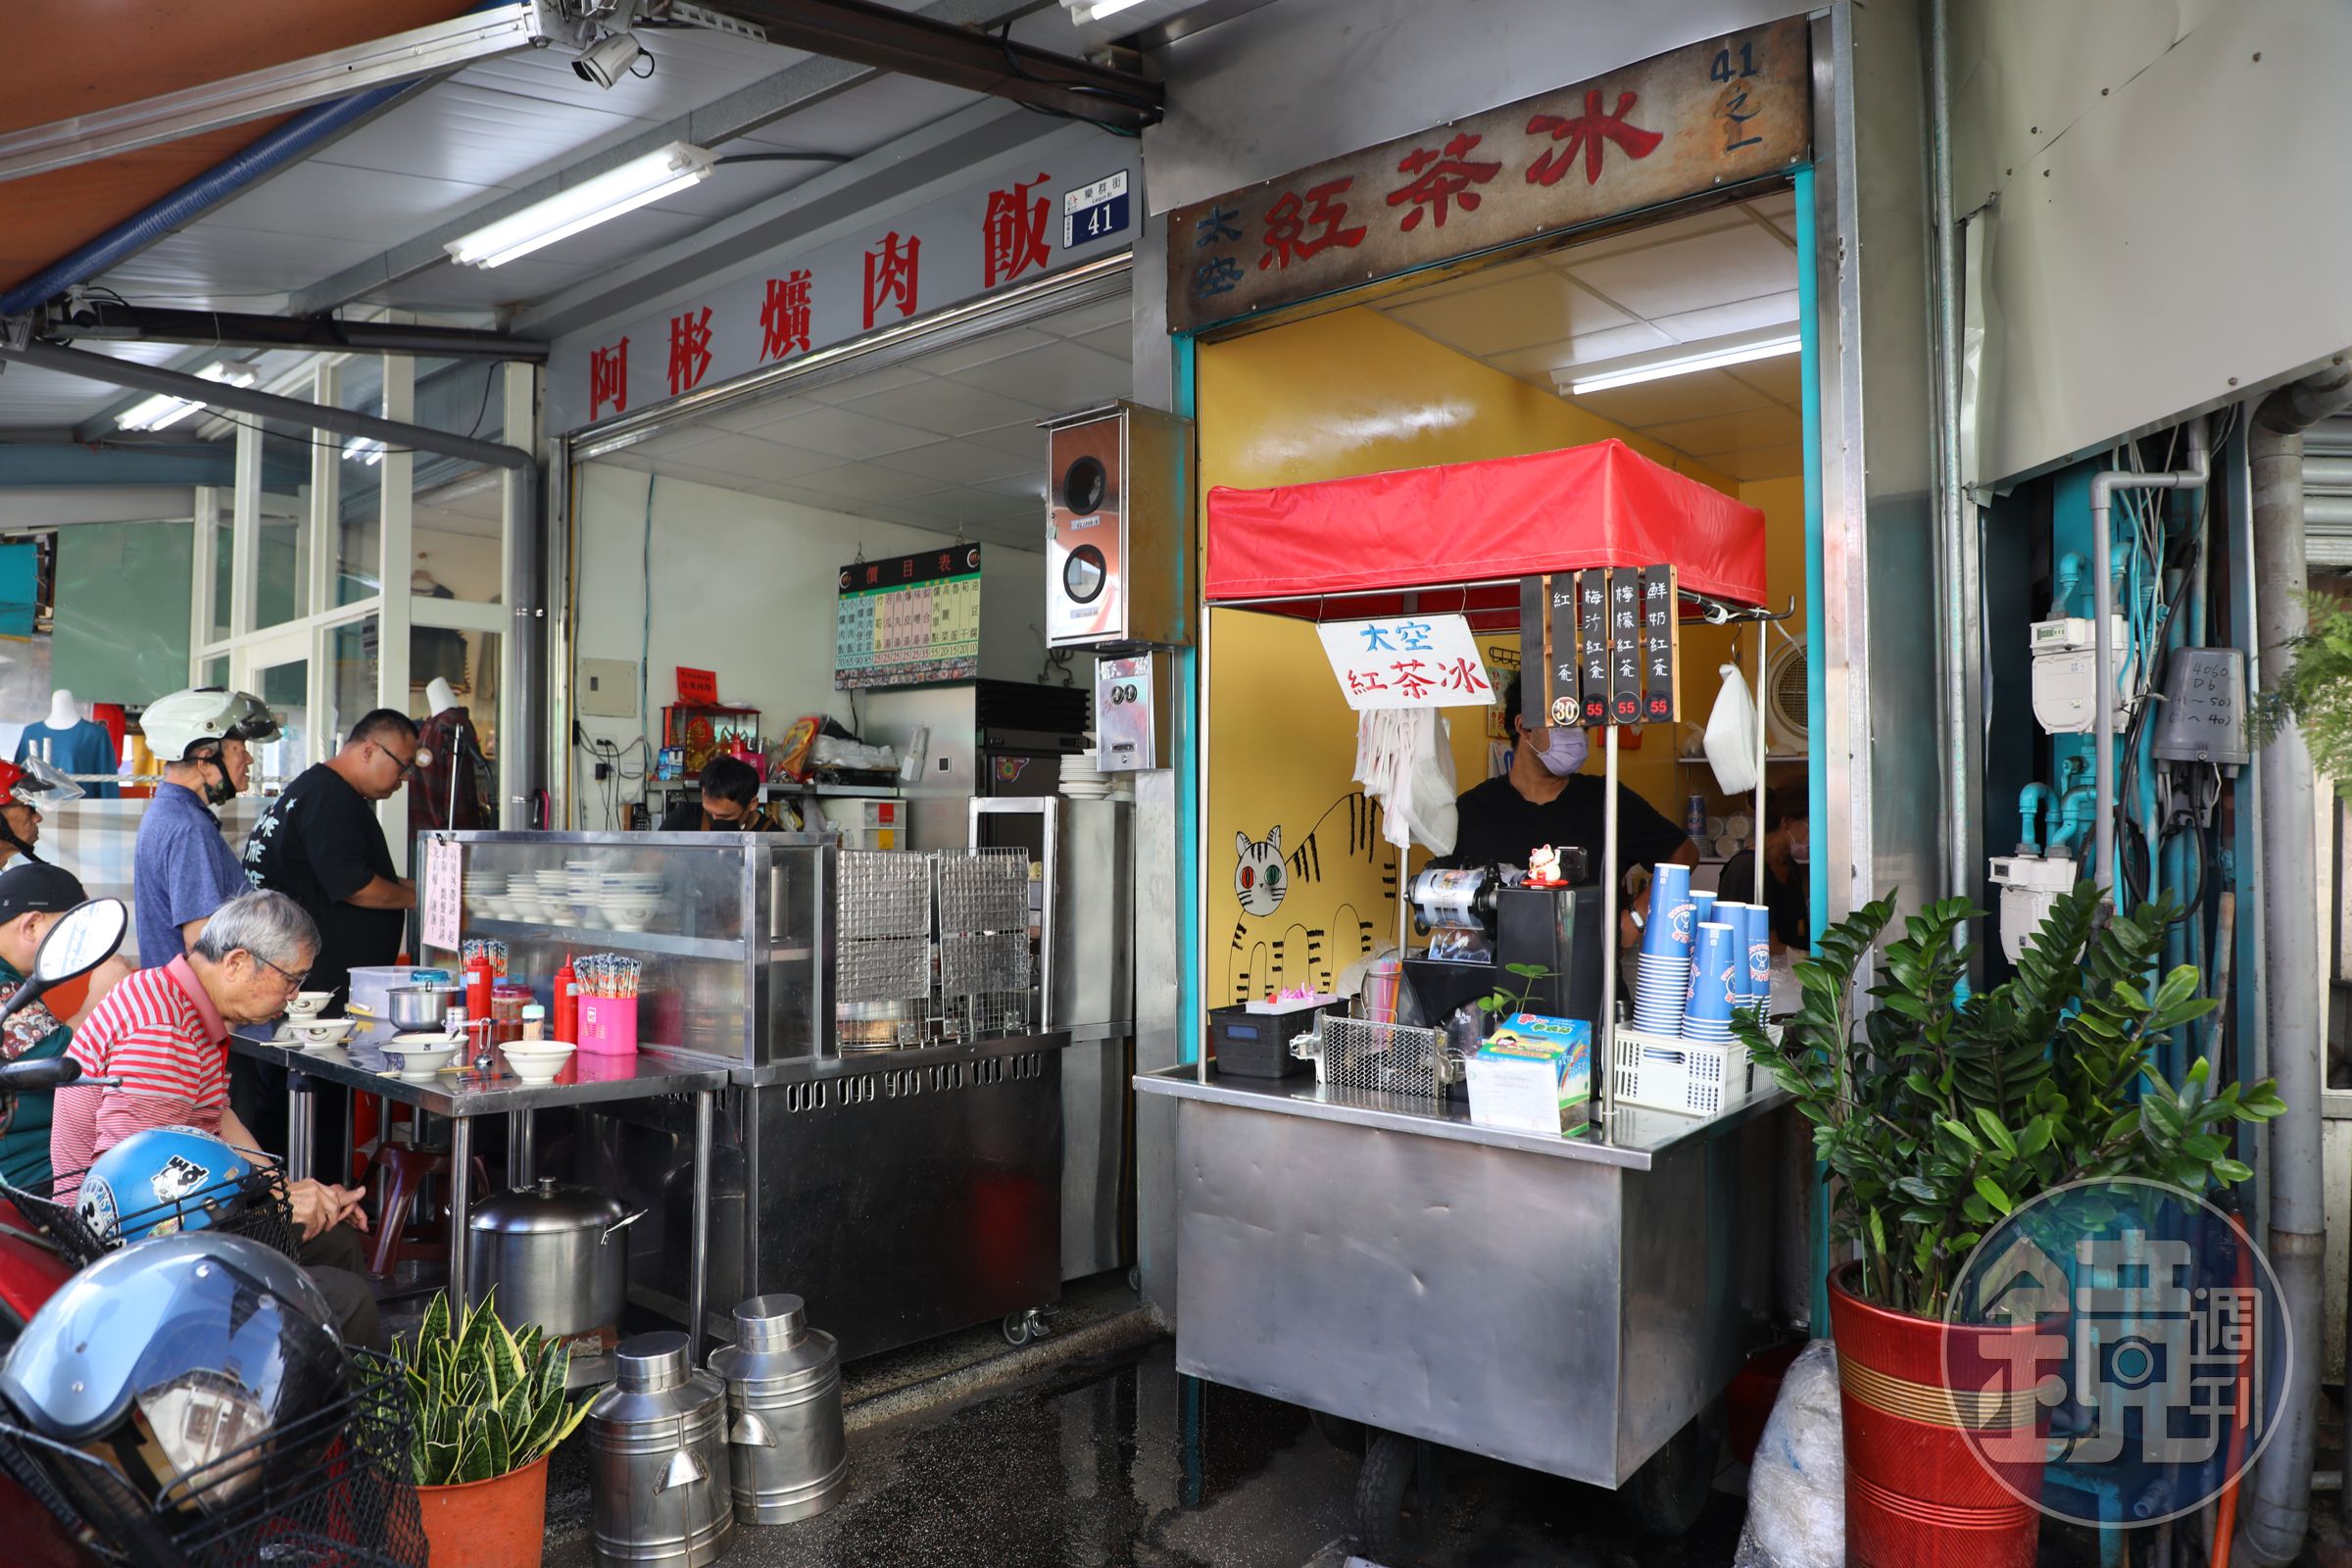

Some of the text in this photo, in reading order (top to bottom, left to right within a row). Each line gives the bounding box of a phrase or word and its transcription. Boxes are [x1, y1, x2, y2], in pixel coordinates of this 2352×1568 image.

[1257, 88, 1663, 273] 紅茶冰
[1088, 203, 1113, 236] 41
[1195, 203, 1245, 298] 太空
[590, 172, 1052, 422] 阿彬爌肉飯
[866, 553, 953, 584] 價目表
[1359, 621, 1435, 652] 太空
[1553, 592, 1573, 682] 紅茶
[1615, 585, 1636, 678] 檸檬紅茶
[1647, 582, 1669, 677] 鮮奶紅茶
[1347, 657, 1490, 700] 紅茶冰
[1554, 701, 1575, 720] 30
[1586, 704, 1603, 716] 55
[1618, 702, 1636, 714] 55
[1650, 701, 1668, 713] 55
